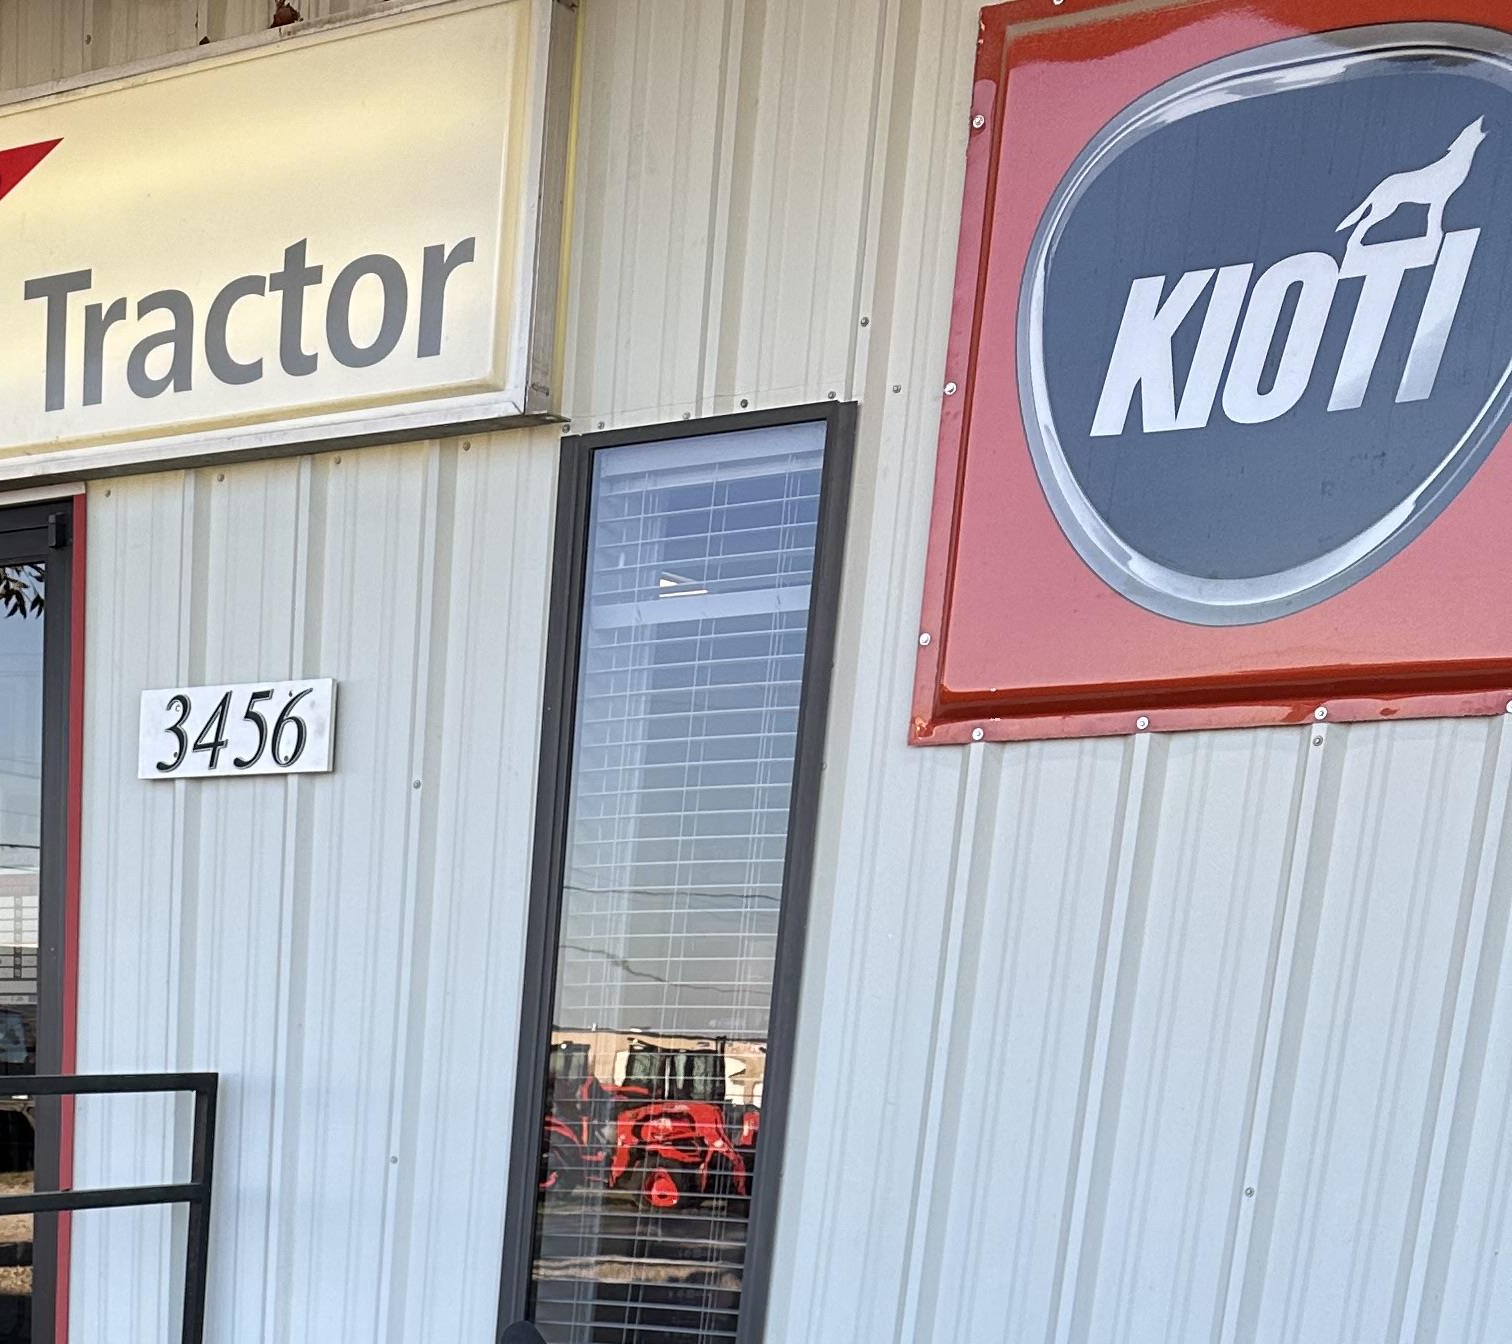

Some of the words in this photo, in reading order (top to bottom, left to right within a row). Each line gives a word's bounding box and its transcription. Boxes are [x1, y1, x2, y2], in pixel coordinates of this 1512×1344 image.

[24, 236, 476, 412] Tractor
[1090, 228, 1481, 437] KIOTI
[155, 687, 314, 773] 3456
